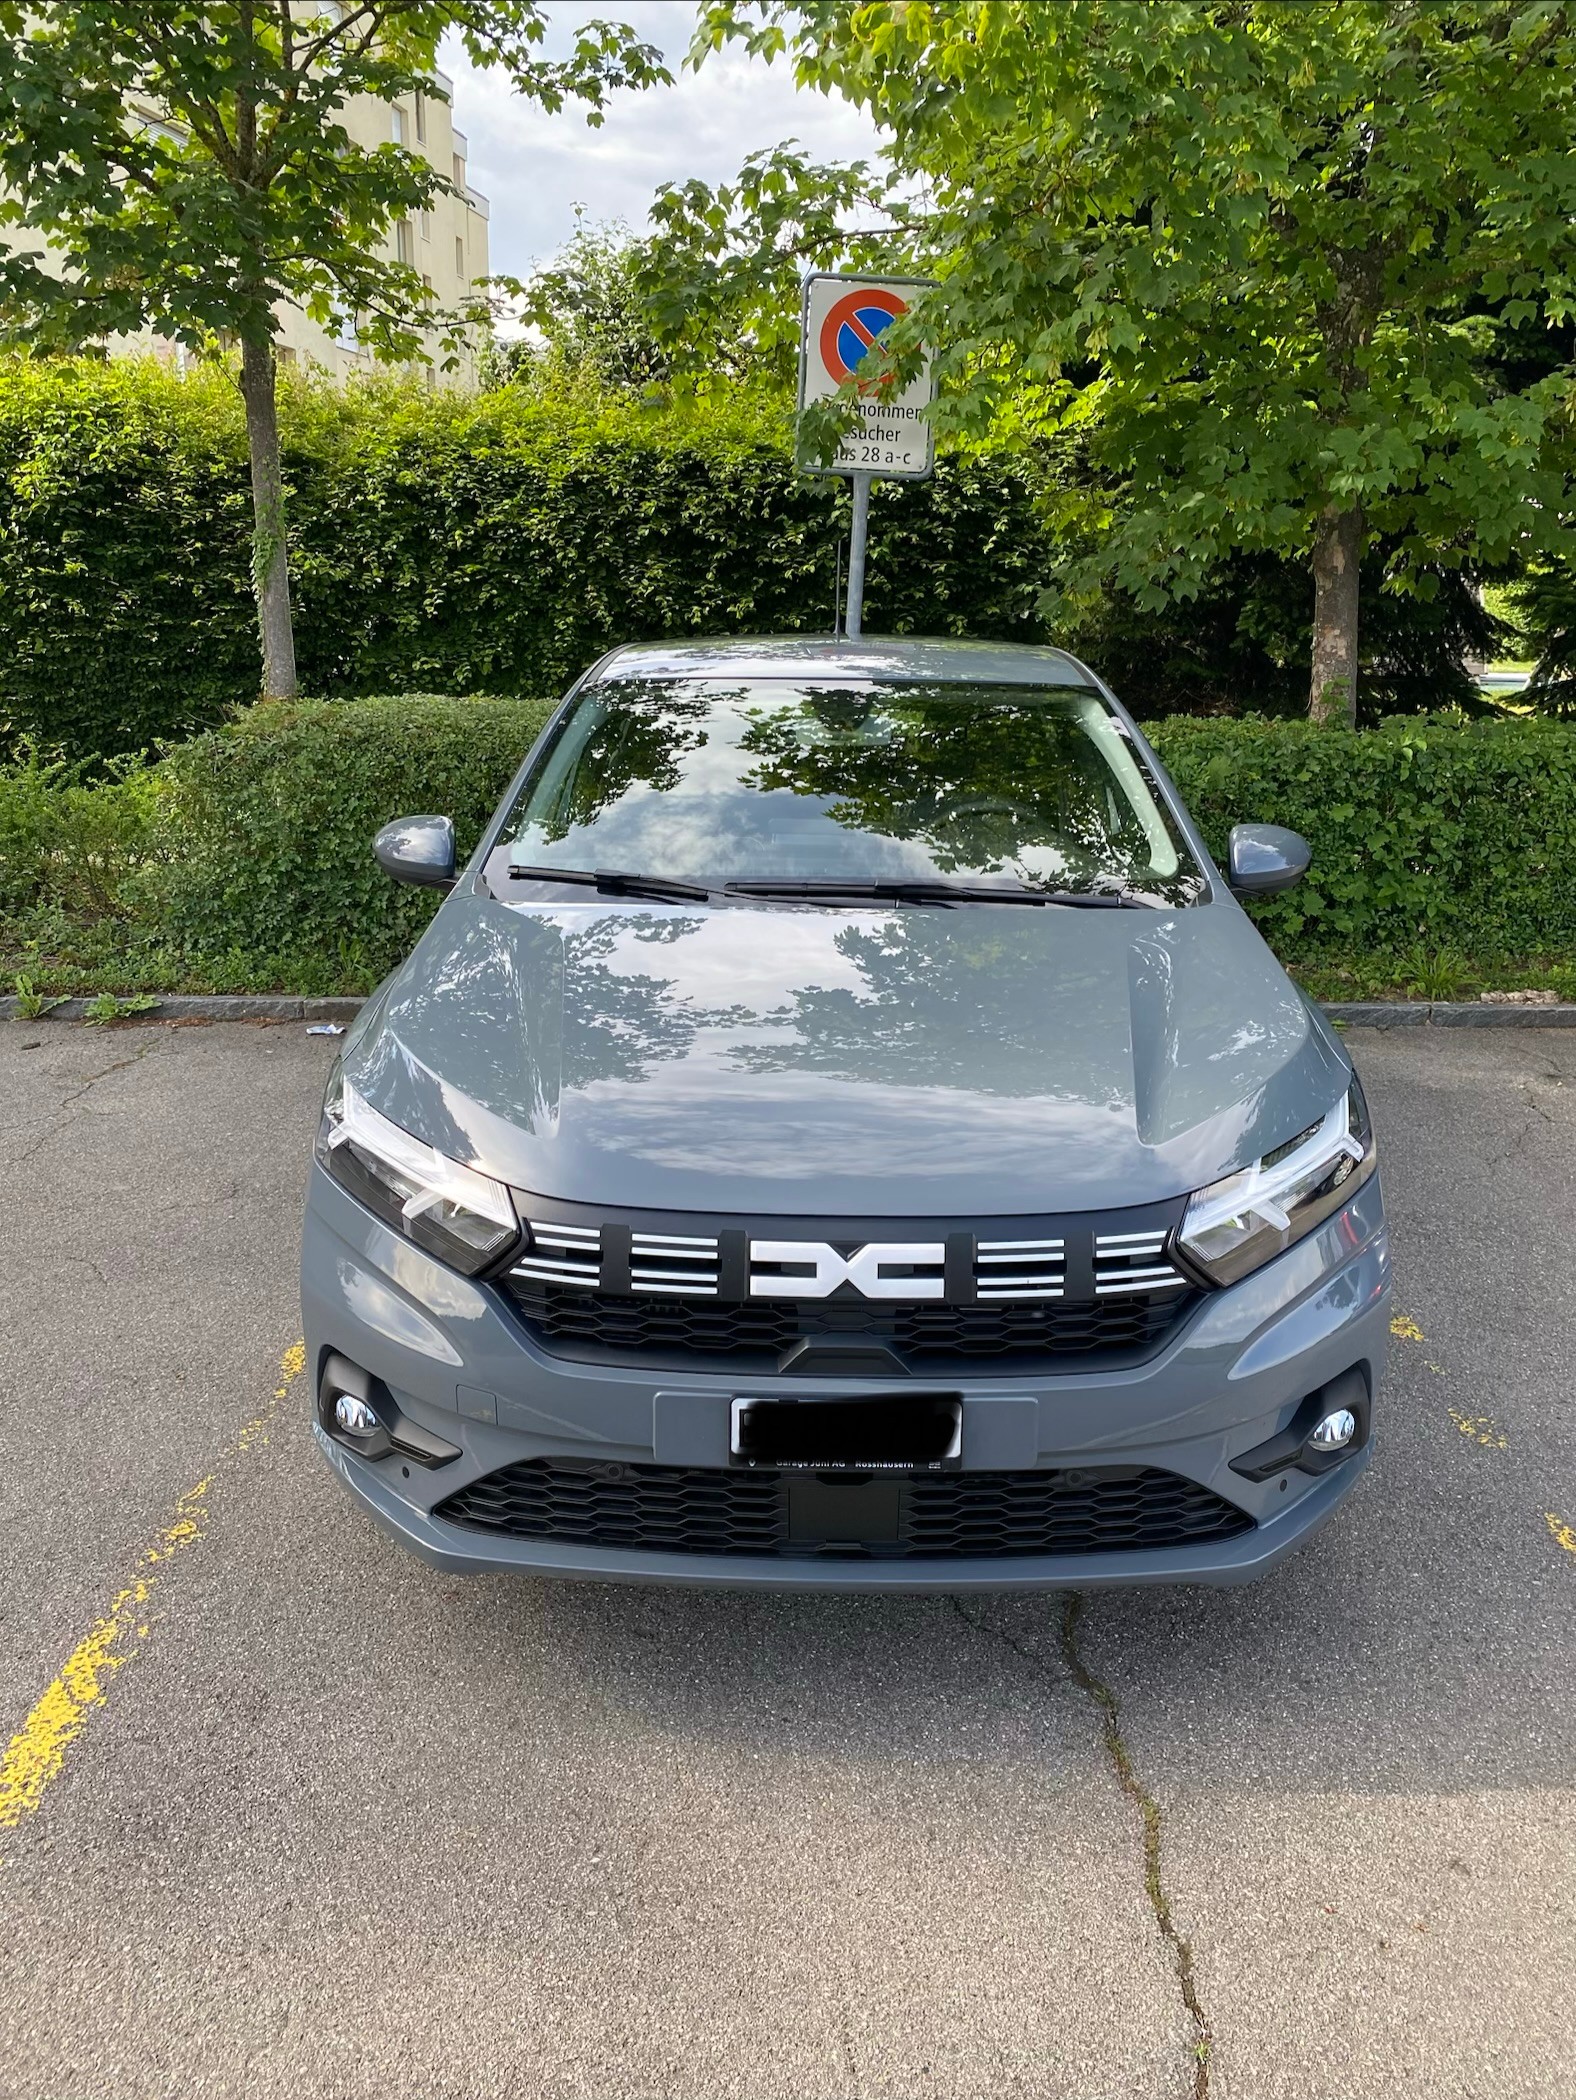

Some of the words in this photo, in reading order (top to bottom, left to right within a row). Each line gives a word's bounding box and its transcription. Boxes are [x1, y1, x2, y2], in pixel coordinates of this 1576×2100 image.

[832, 447, 857, 461] aus
[861, 446, 880, 463] 28
[776, 1459, 808, 1468] Garage
[832, 1459, 846, 1467] AG
